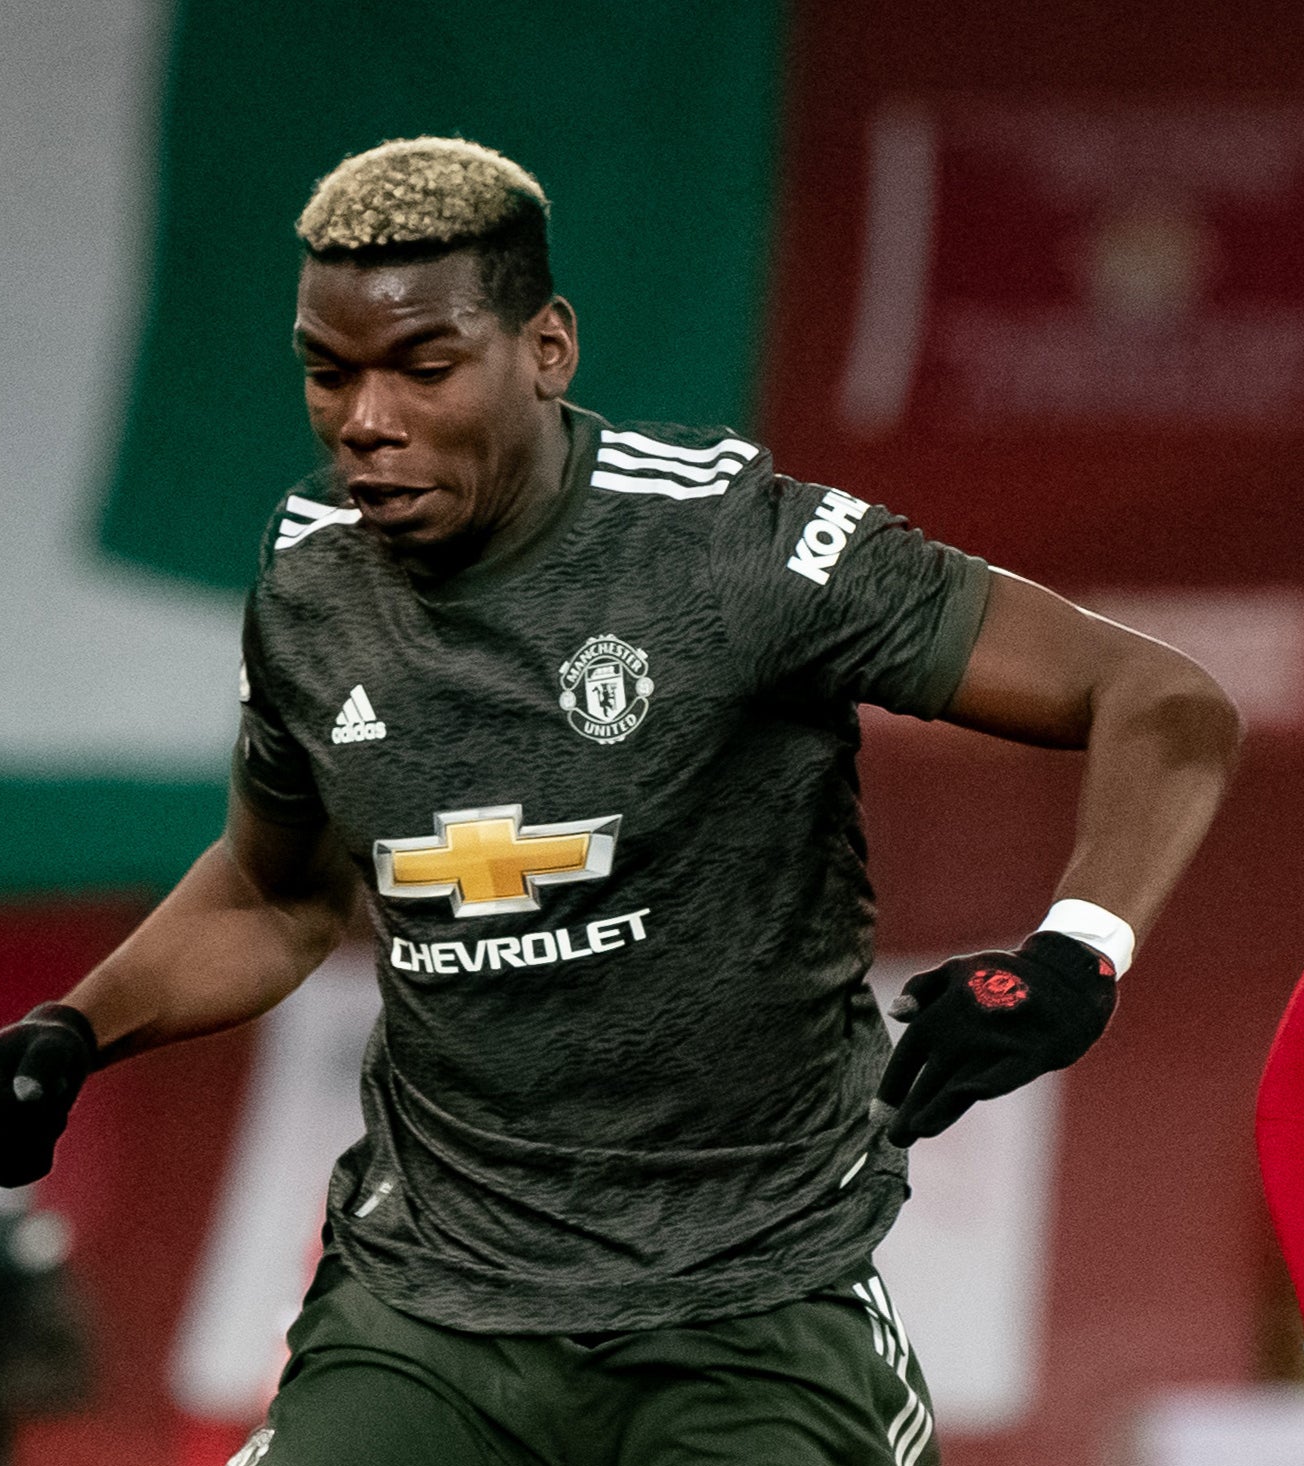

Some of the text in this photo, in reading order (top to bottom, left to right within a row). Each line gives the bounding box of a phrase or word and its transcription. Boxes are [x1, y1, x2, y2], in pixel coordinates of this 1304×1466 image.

[566, 642, 643, 684] MANCHESTER
[331, 721, 387, 744] adidas
[584, 713, 637, 737] UNITED
[390, 908, 661, 974] CHEVROLET
